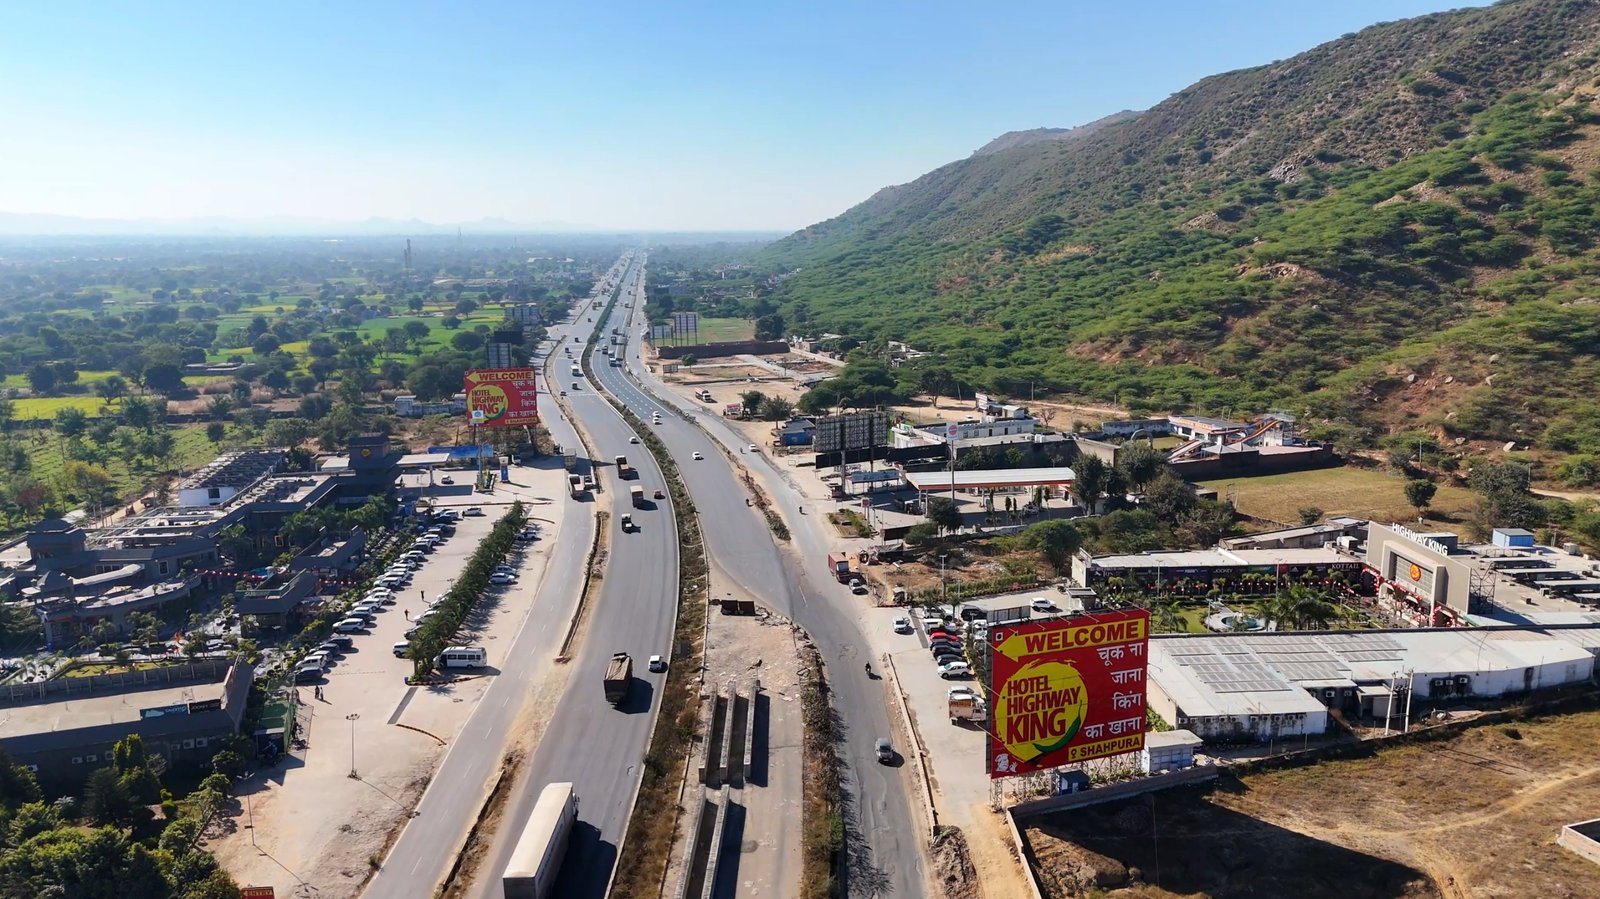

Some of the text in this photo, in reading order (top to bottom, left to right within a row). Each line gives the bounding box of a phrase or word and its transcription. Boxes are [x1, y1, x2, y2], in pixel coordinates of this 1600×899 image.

[480, 372, 532, 380] WELCOME
[472, 396, 504, 404] HIGHWAY
[1392, 522, 1448, 556] HIGHWAY KING
[1026, 621, 1138, 652] WELCOME
[1097, 642, 1144, 666] चूक ना
[1008, 676, 1052, 696] HOTEL
[1110, 668, 1143, 684] जाना
[1007, 686, 1081, 716] HIGHWAY
[1112, 691, 1142, 710] किंग
[1006, 708, 1066, 745] KING
[1084, 716, 1142, 738] का खाना
[1080, 737, 1140, 757] SHAHPURA
